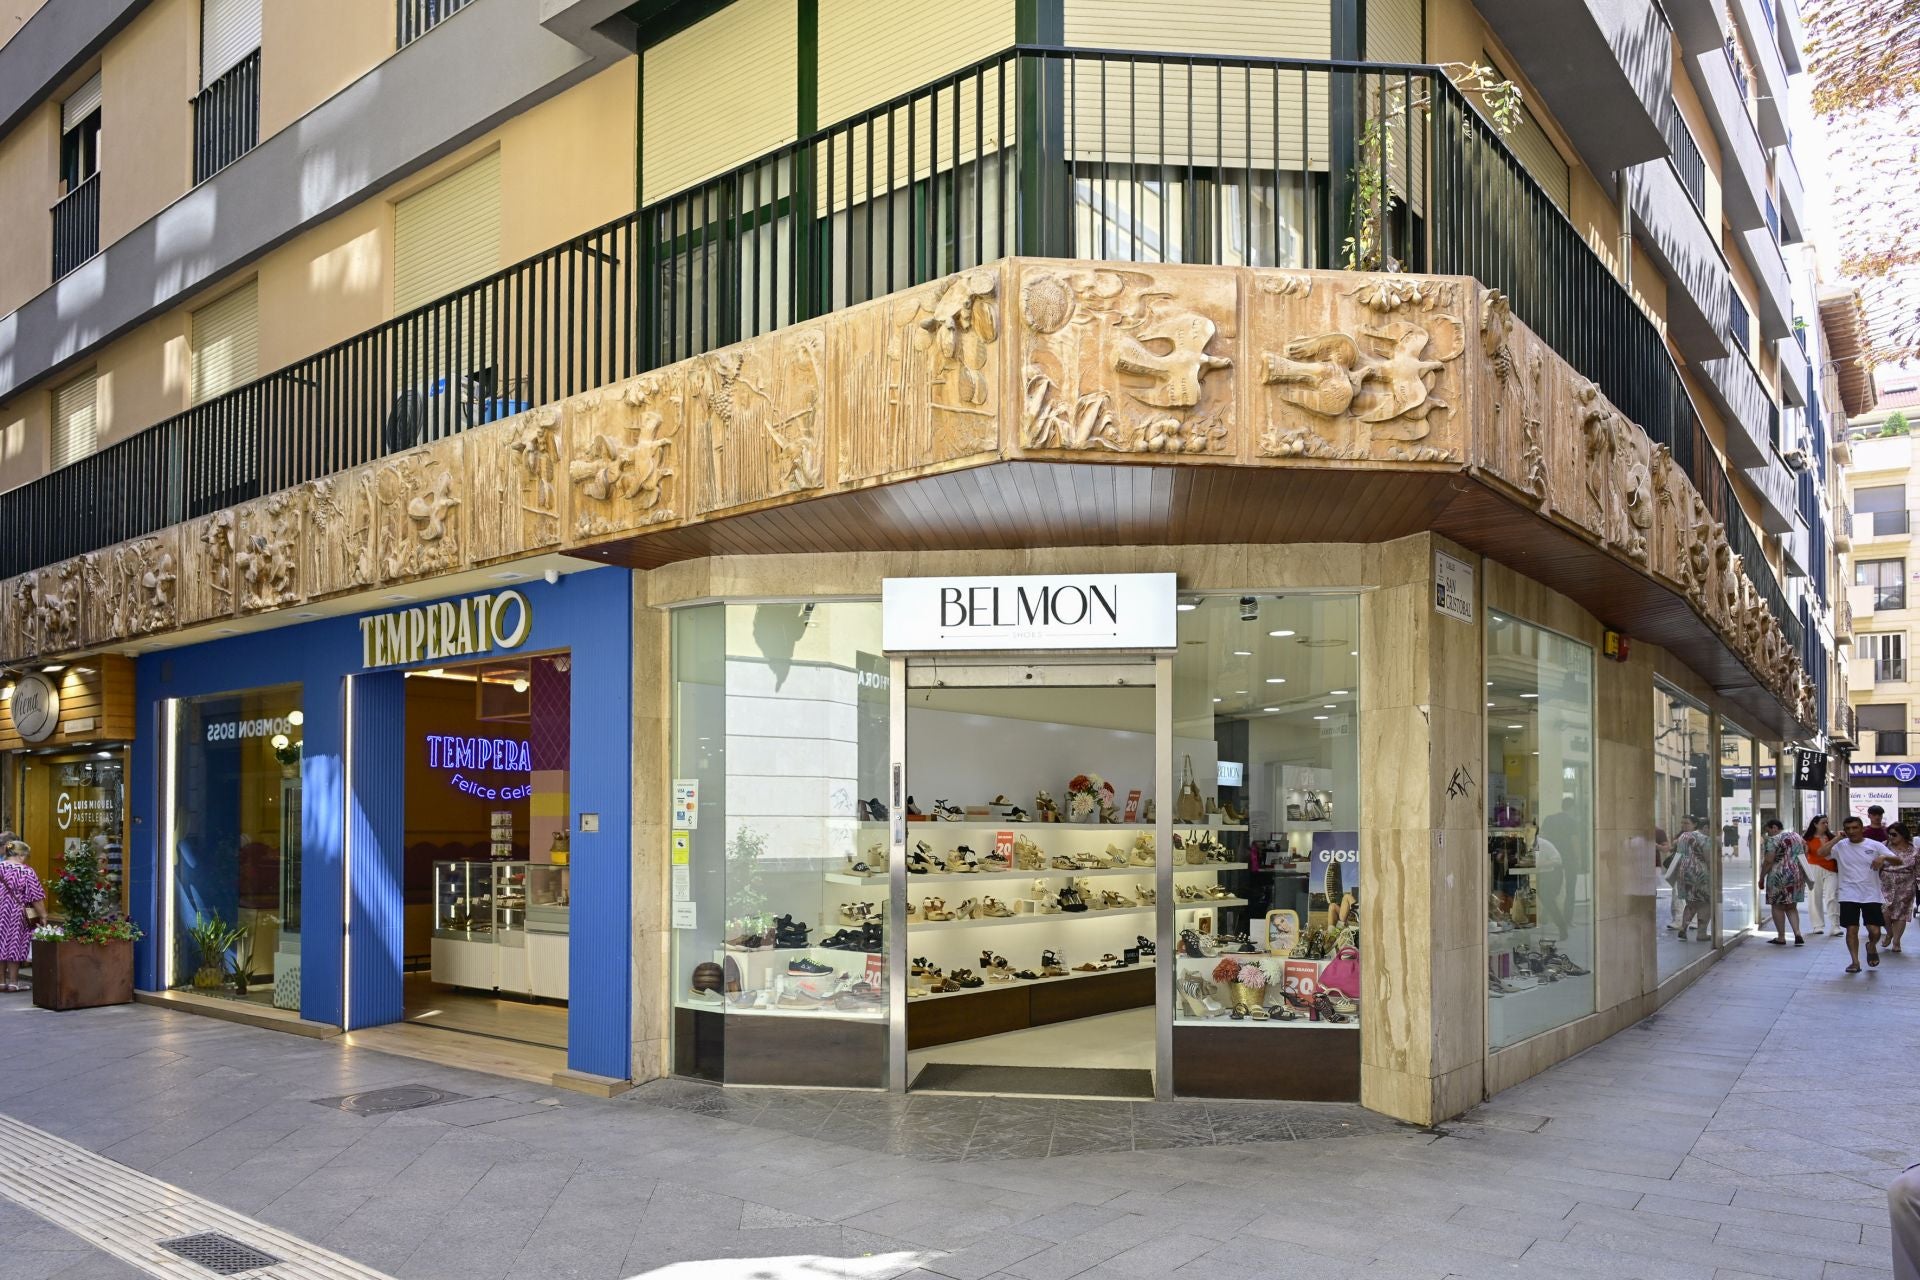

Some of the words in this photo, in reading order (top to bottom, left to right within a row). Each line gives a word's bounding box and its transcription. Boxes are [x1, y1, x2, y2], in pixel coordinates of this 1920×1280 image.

[1446, 576, 1456, 595] SAN
[939, 584, 1117, 627] BELMON
[359, 589, 530, 669] TEMPERATO
[426, 735, 532, 771] TEMPERA
[451, 774, 497, 800] Felice
[73, 800, 88, 810] LUIS
[89, 799, 114, 810] MIGUEL
[1126, 800, 1137, 812] 20
[997, 843, 1012, 855] 20
[866, 970, 881, 985] 20
[1285, 976, 1314, 995] 20
